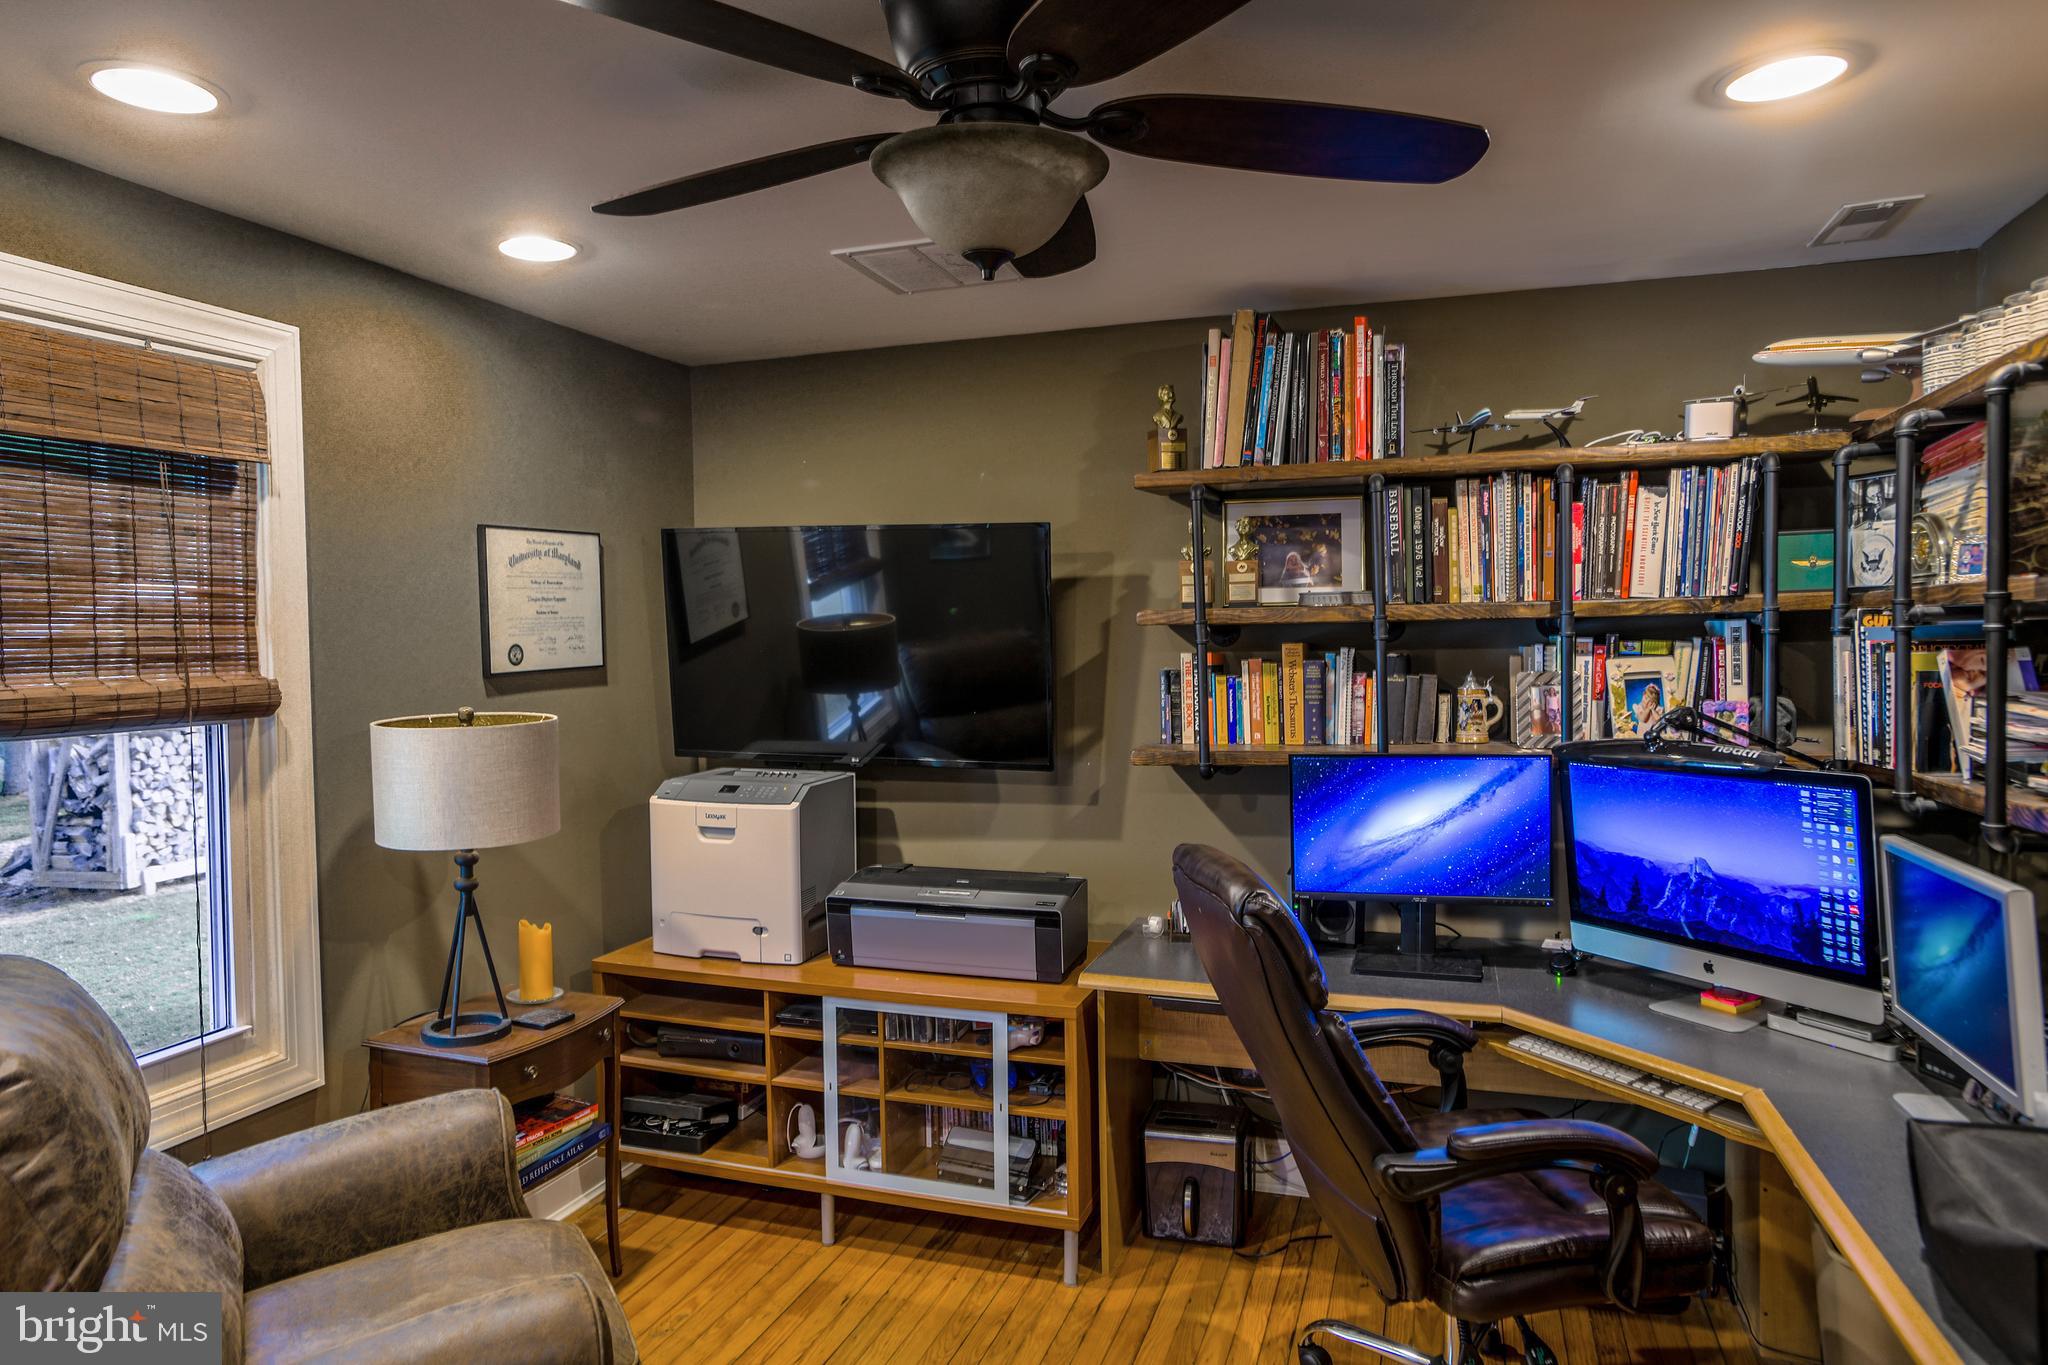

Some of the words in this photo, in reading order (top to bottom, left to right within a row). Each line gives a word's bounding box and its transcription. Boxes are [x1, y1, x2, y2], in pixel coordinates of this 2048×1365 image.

[1390, 362, 1399, 402] THROUGH
[1390, 421, 1398, 440] LENS
[1388, 489, 1400, 556] BASEBALL
[1650, 521, 1660, 536] York
[1736, 495, 1746, 532] YEARBOOK
[1650, 536, 1658, 555] Times
[1862, 614, 1892, 628] GUI
[1288, 660, 1296, 696] Webster's
[1288, 696, 1298, 739] Thesaurus
[529, 1156, 564, 1180] REFERENCE
[565, 1142, 584, 1158] ATLAS
